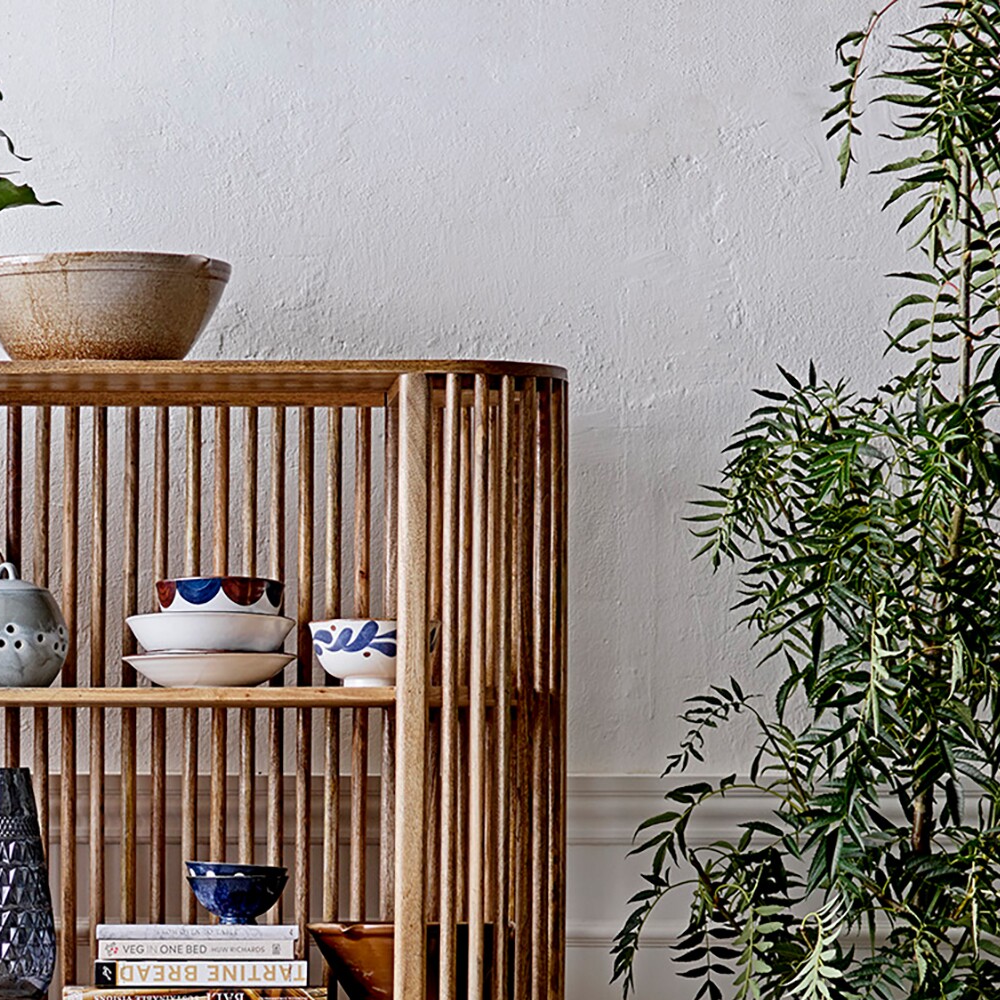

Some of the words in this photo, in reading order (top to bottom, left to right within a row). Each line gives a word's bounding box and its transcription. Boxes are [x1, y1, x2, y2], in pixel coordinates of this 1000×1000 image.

[122, 945, 145, 955] VEG
[147, 945, 158, 955] IN
[160, 945, 183, 955] ONE
[186, 945, 207, 955] BED
[119, 965, 198, 981] BREAD
[207, 965, 306, 981] TARTINE
